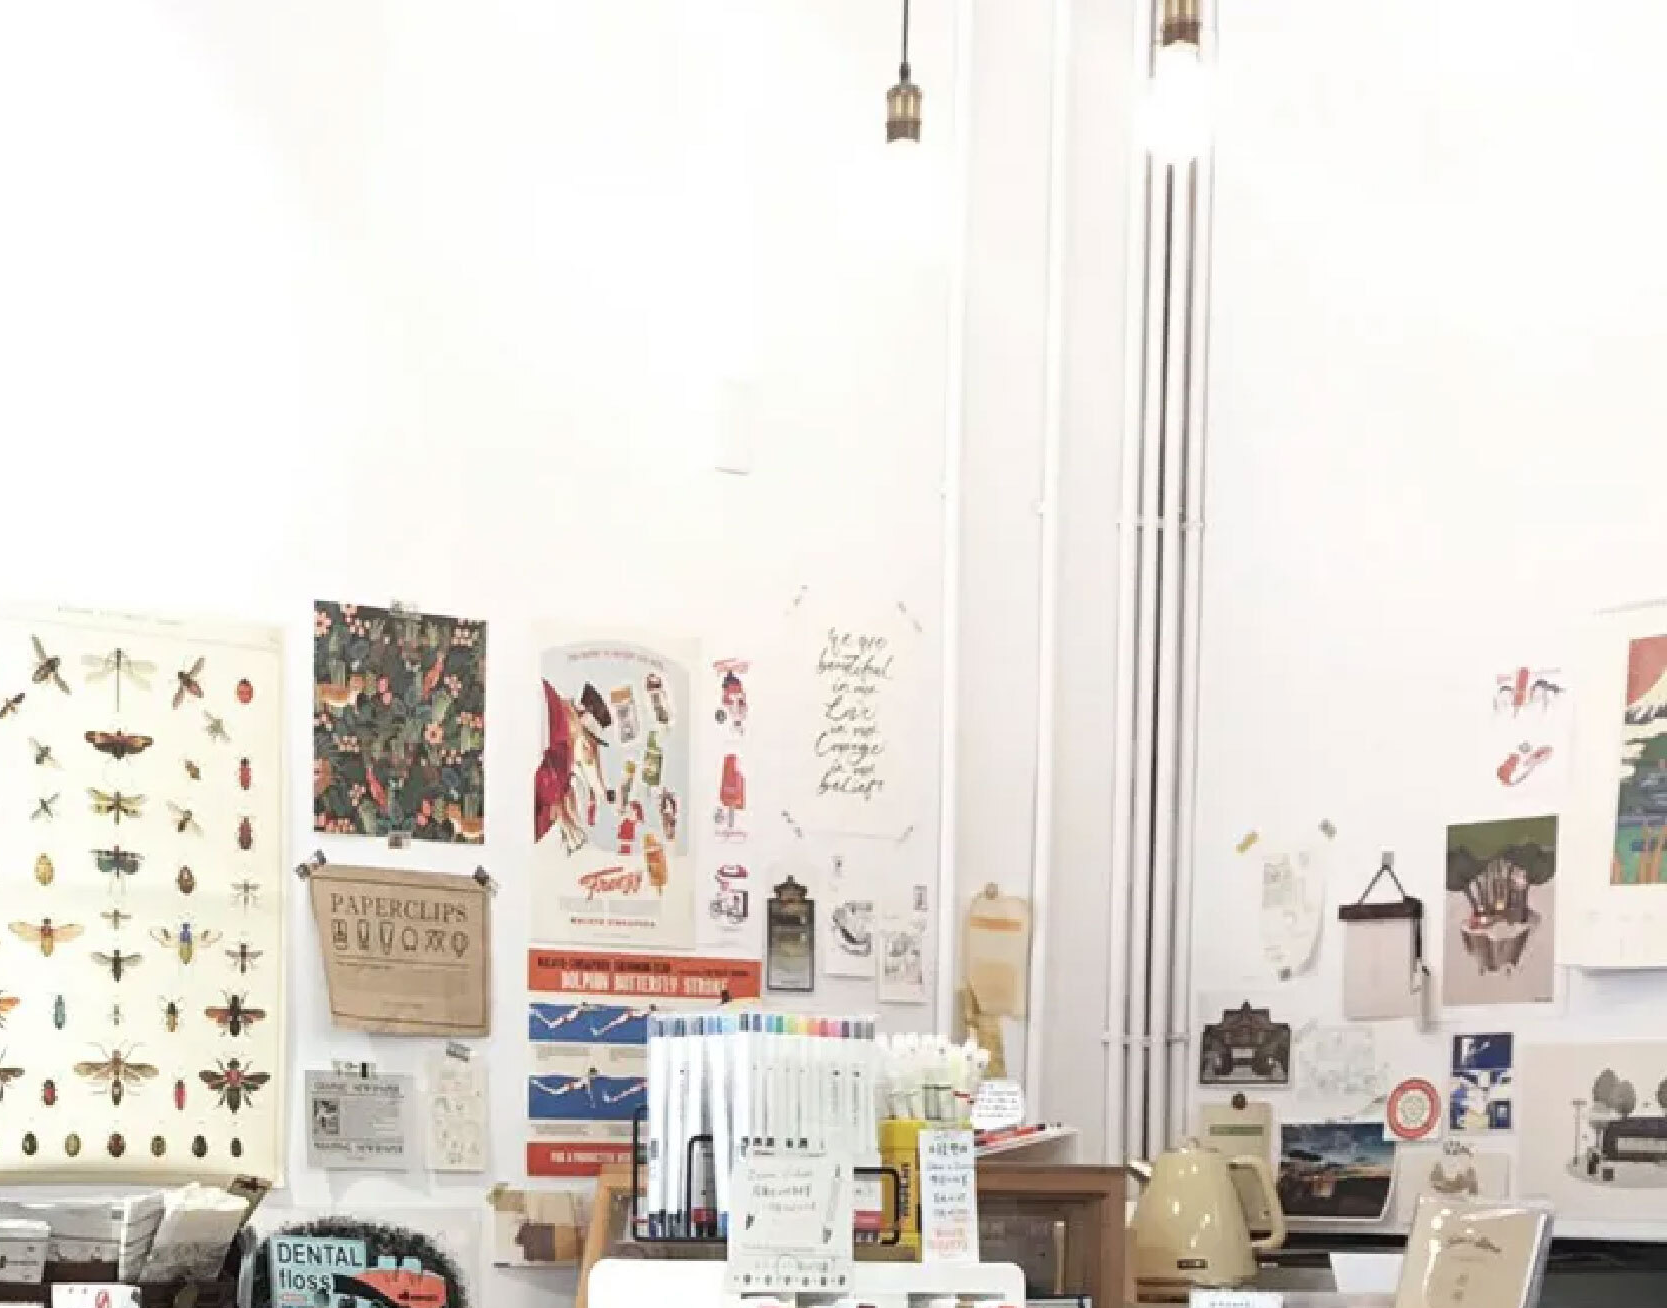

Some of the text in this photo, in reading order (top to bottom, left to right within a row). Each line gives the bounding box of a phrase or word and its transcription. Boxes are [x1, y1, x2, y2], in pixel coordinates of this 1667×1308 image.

[331, 893, 468, 923] PAPERCLIPS
[277, 1242, 363, 1267] DENTAL
[278, 1267, 332, 1290] floss
